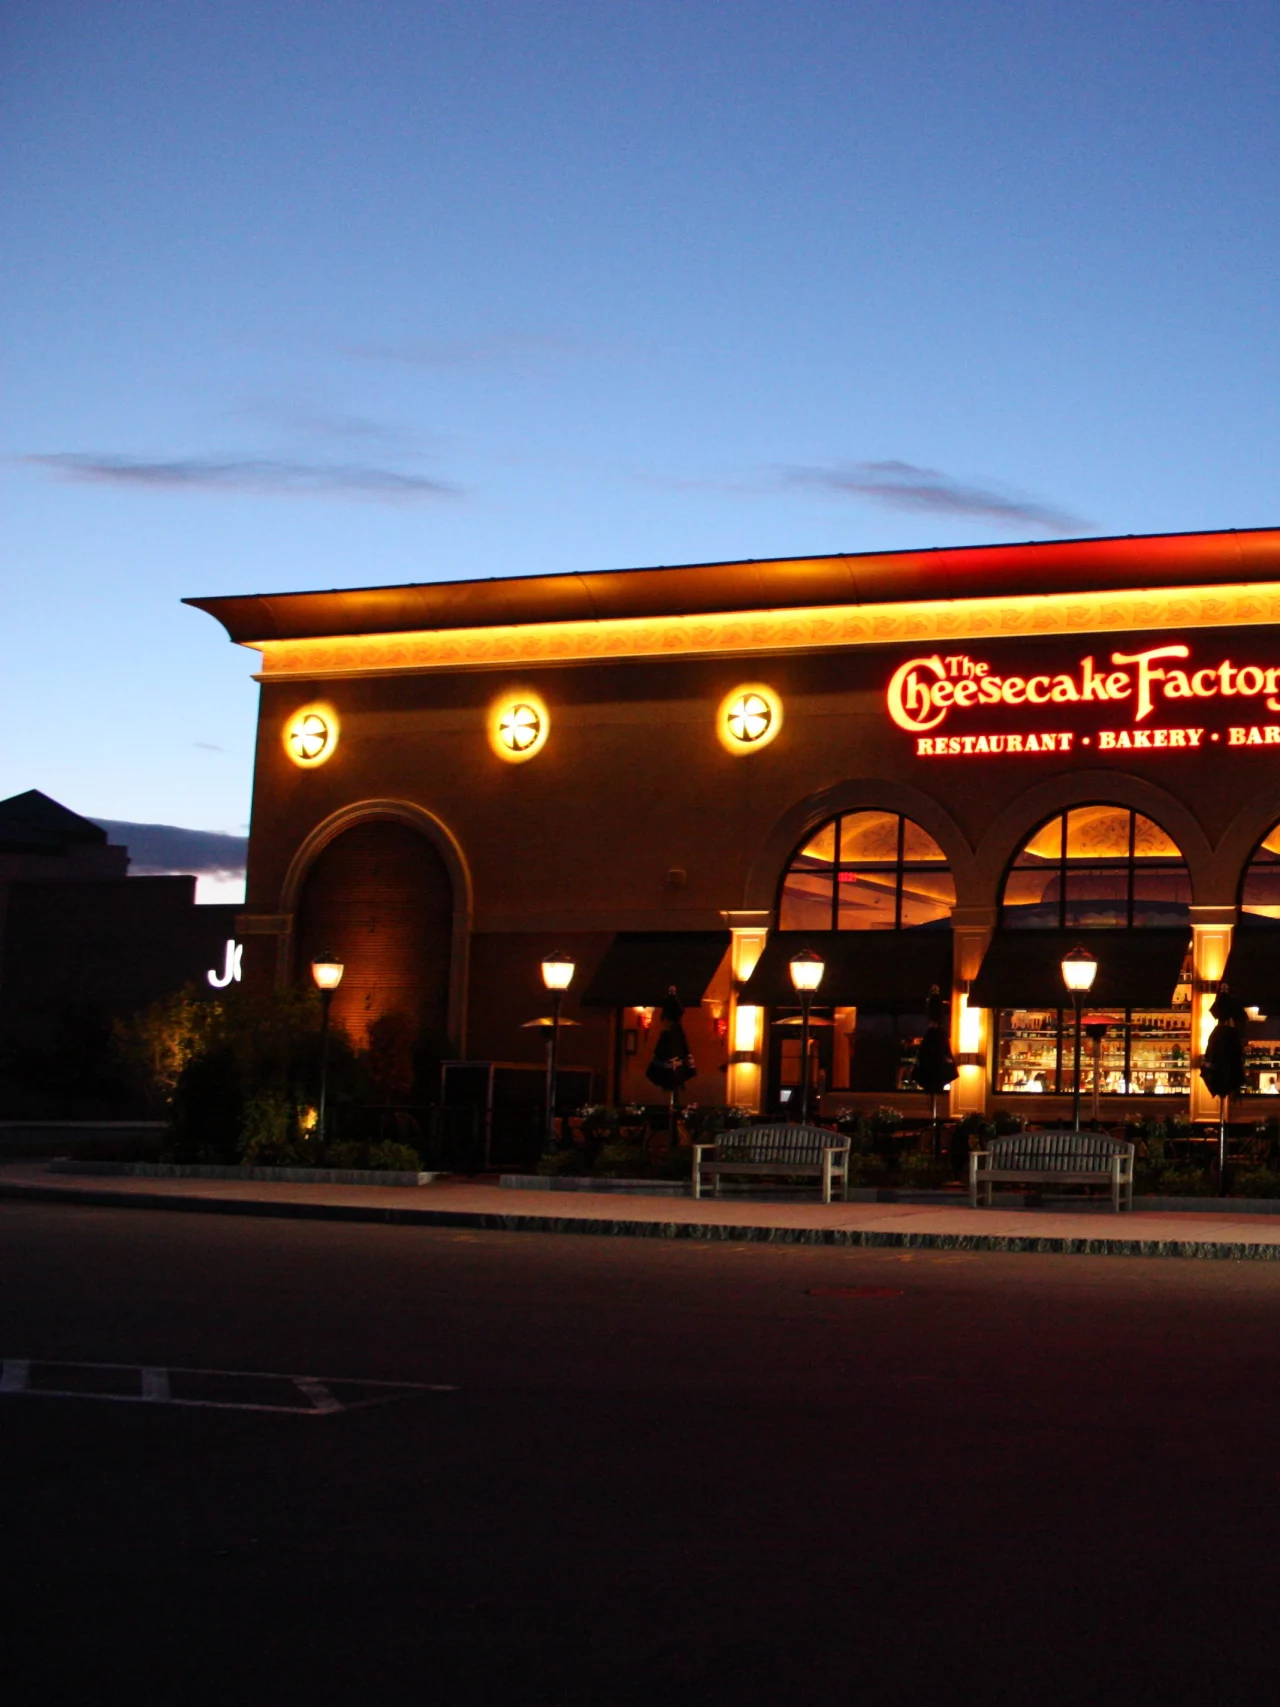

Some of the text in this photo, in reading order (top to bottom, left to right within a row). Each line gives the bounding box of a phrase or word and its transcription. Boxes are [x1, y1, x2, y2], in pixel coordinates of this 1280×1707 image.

[945, 655, 988, 679] The
[887, 654, 1132, 731] Cheesecake
[916, 732, 1073, 755] RESTAURANT
[1098, 728, 1204, 749] BAKERY
